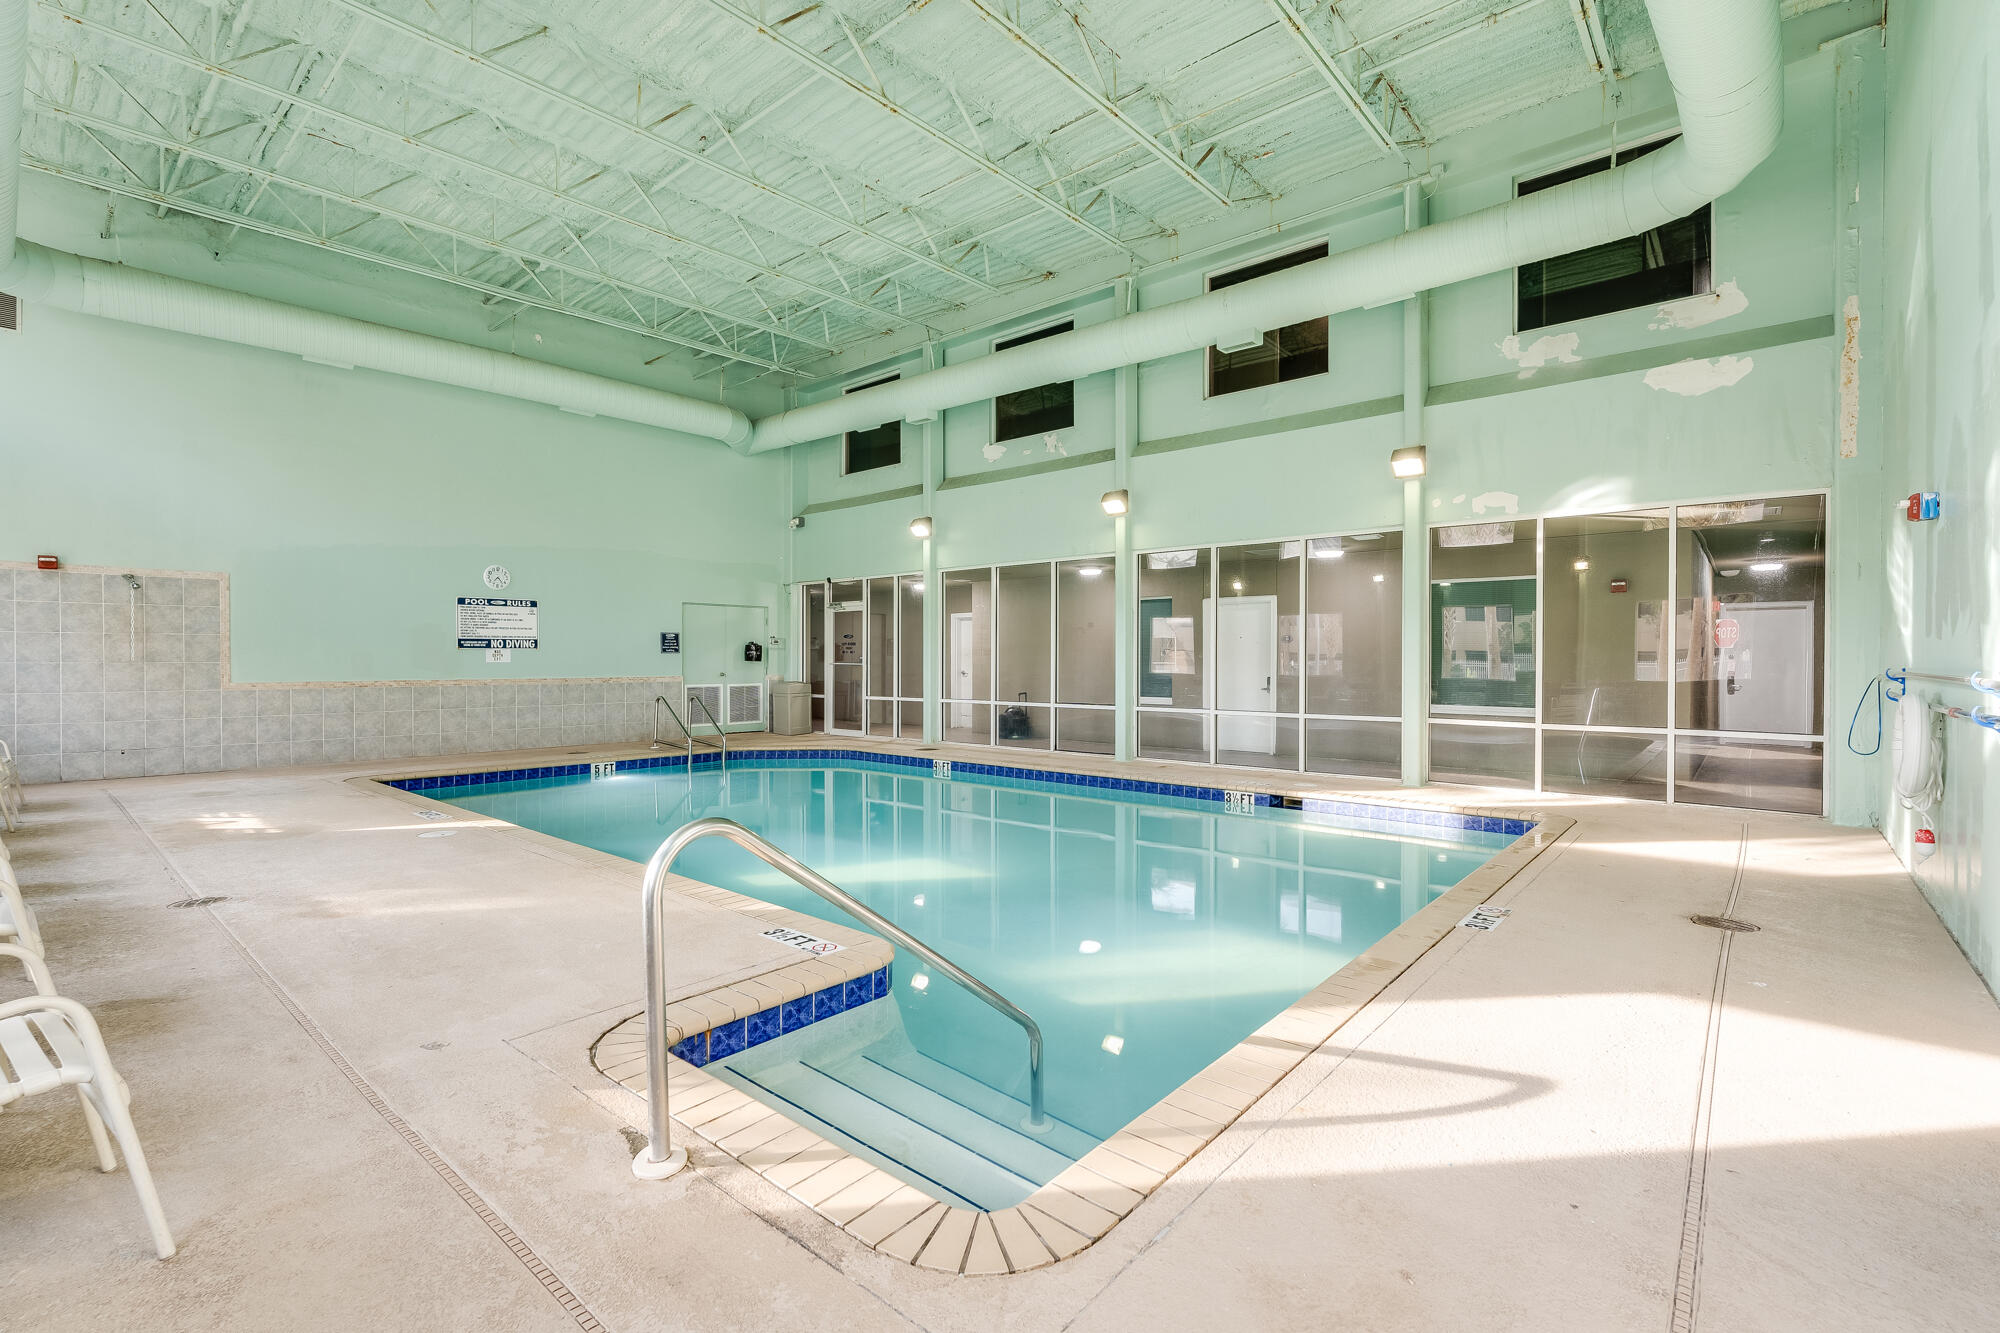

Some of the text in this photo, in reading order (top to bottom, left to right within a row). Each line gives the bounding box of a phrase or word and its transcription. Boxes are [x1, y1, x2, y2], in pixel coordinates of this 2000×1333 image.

[465, 598, 489, 606] POOL
[490, 640, 535, 648] NO DIVING
[594, 764, 600, 774] 5
